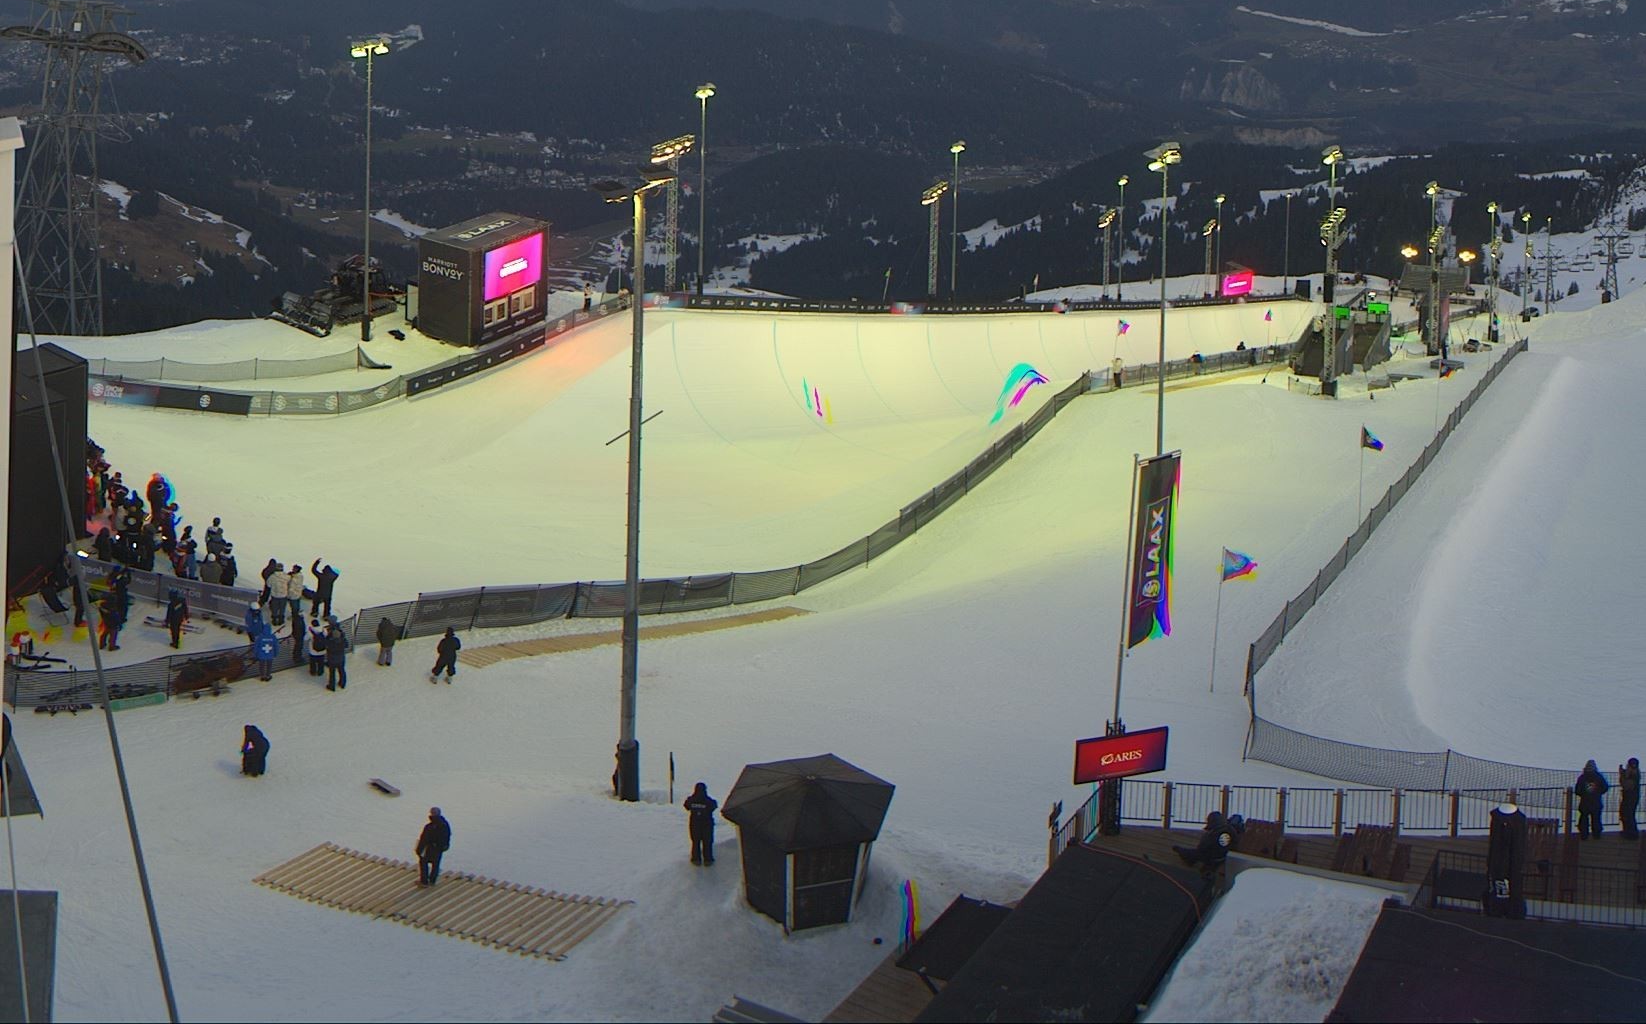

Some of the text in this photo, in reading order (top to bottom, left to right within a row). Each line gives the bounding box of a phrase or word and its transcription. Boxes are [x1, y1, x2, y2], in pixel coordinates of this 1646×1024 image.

[422, 261, 463, 280] BONVOY
[427, 256, 458, 269] MARRIOTT
[1145, 505, 1165, 577] LAAX
[1114, 749, 1143, 763] ARES
